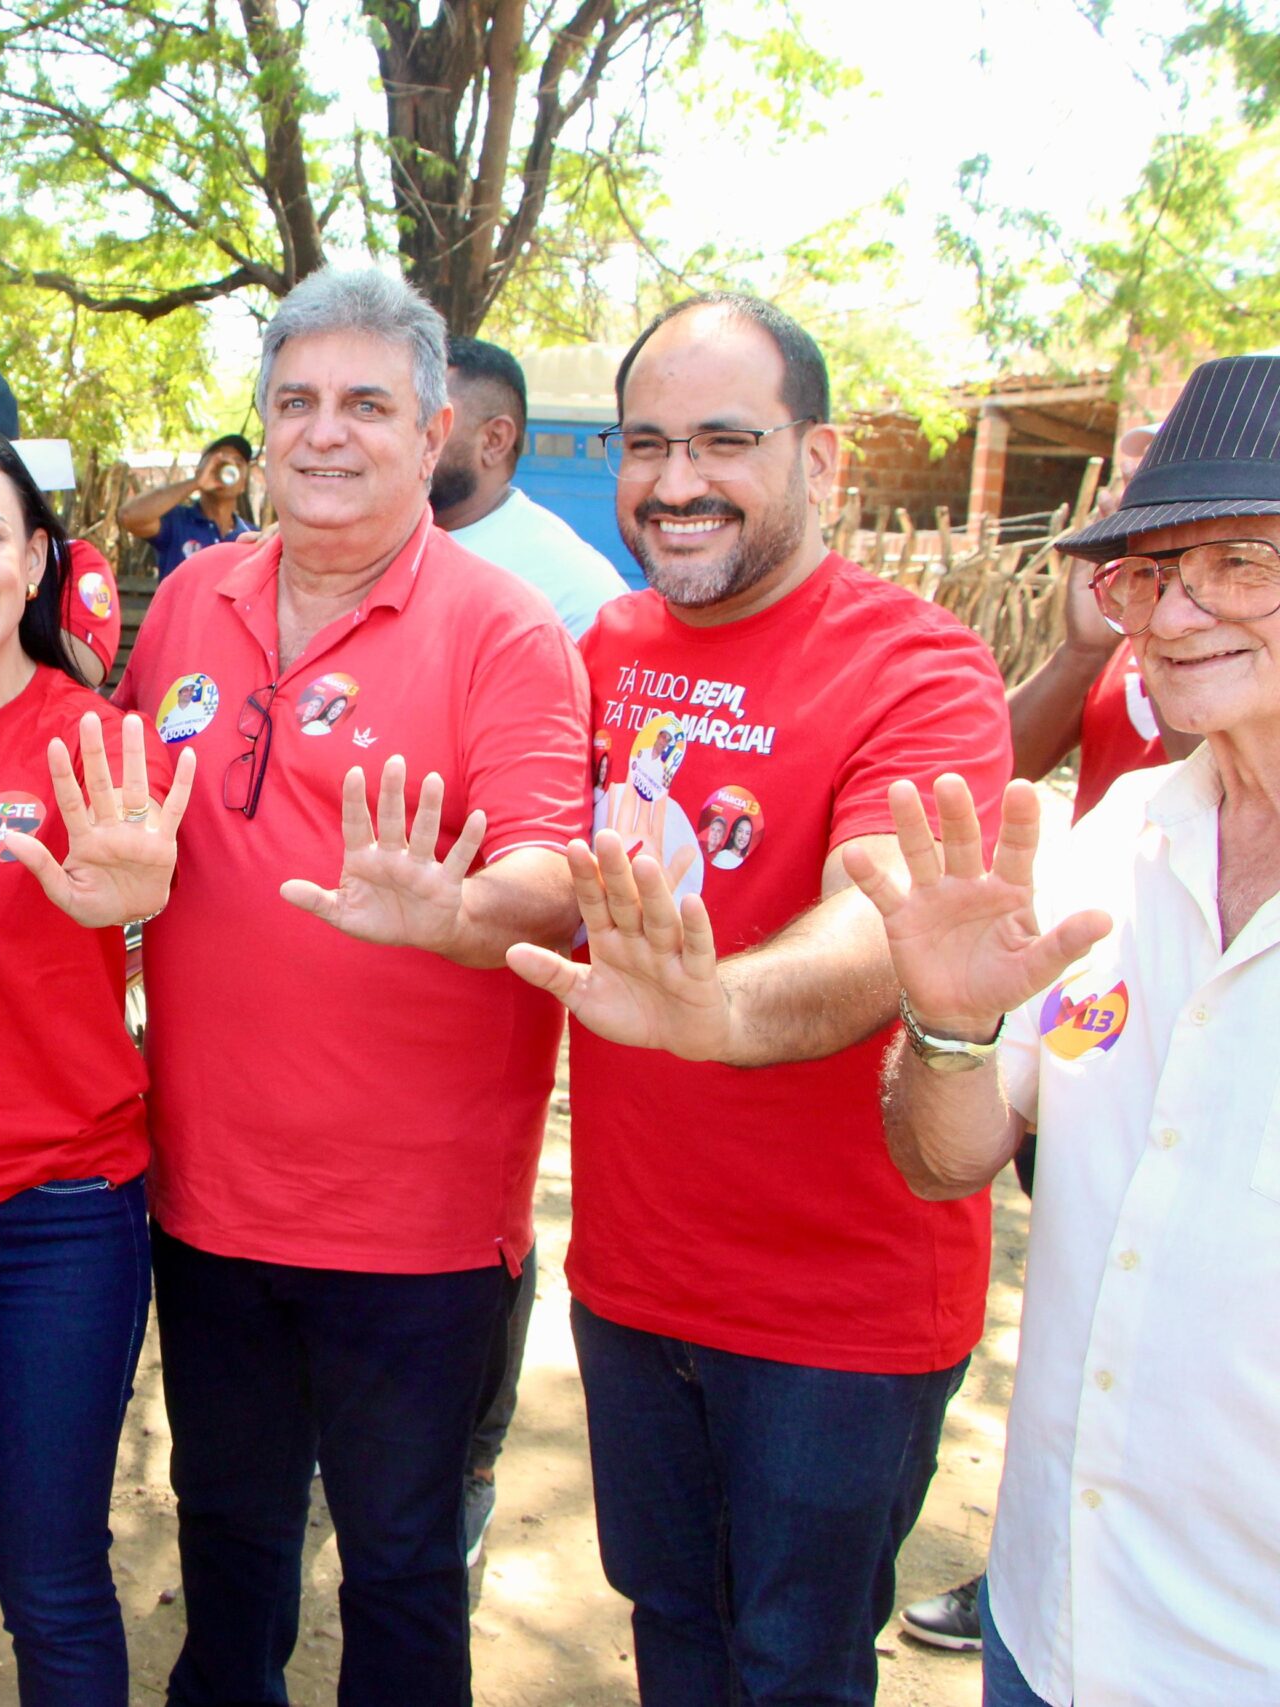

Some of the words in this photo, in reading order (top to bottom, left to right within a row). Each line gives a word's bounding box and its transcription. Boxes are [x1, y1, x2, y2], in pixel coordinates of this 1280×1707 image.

[616, 660, 639, 693] TÁ
[639, 669, 689, 702] TUDO
[689, 679, 746, 718] BEM,
[603, 696, 629, 728] TÁ
[680, 709, 776, 754] MÁRCIA!
